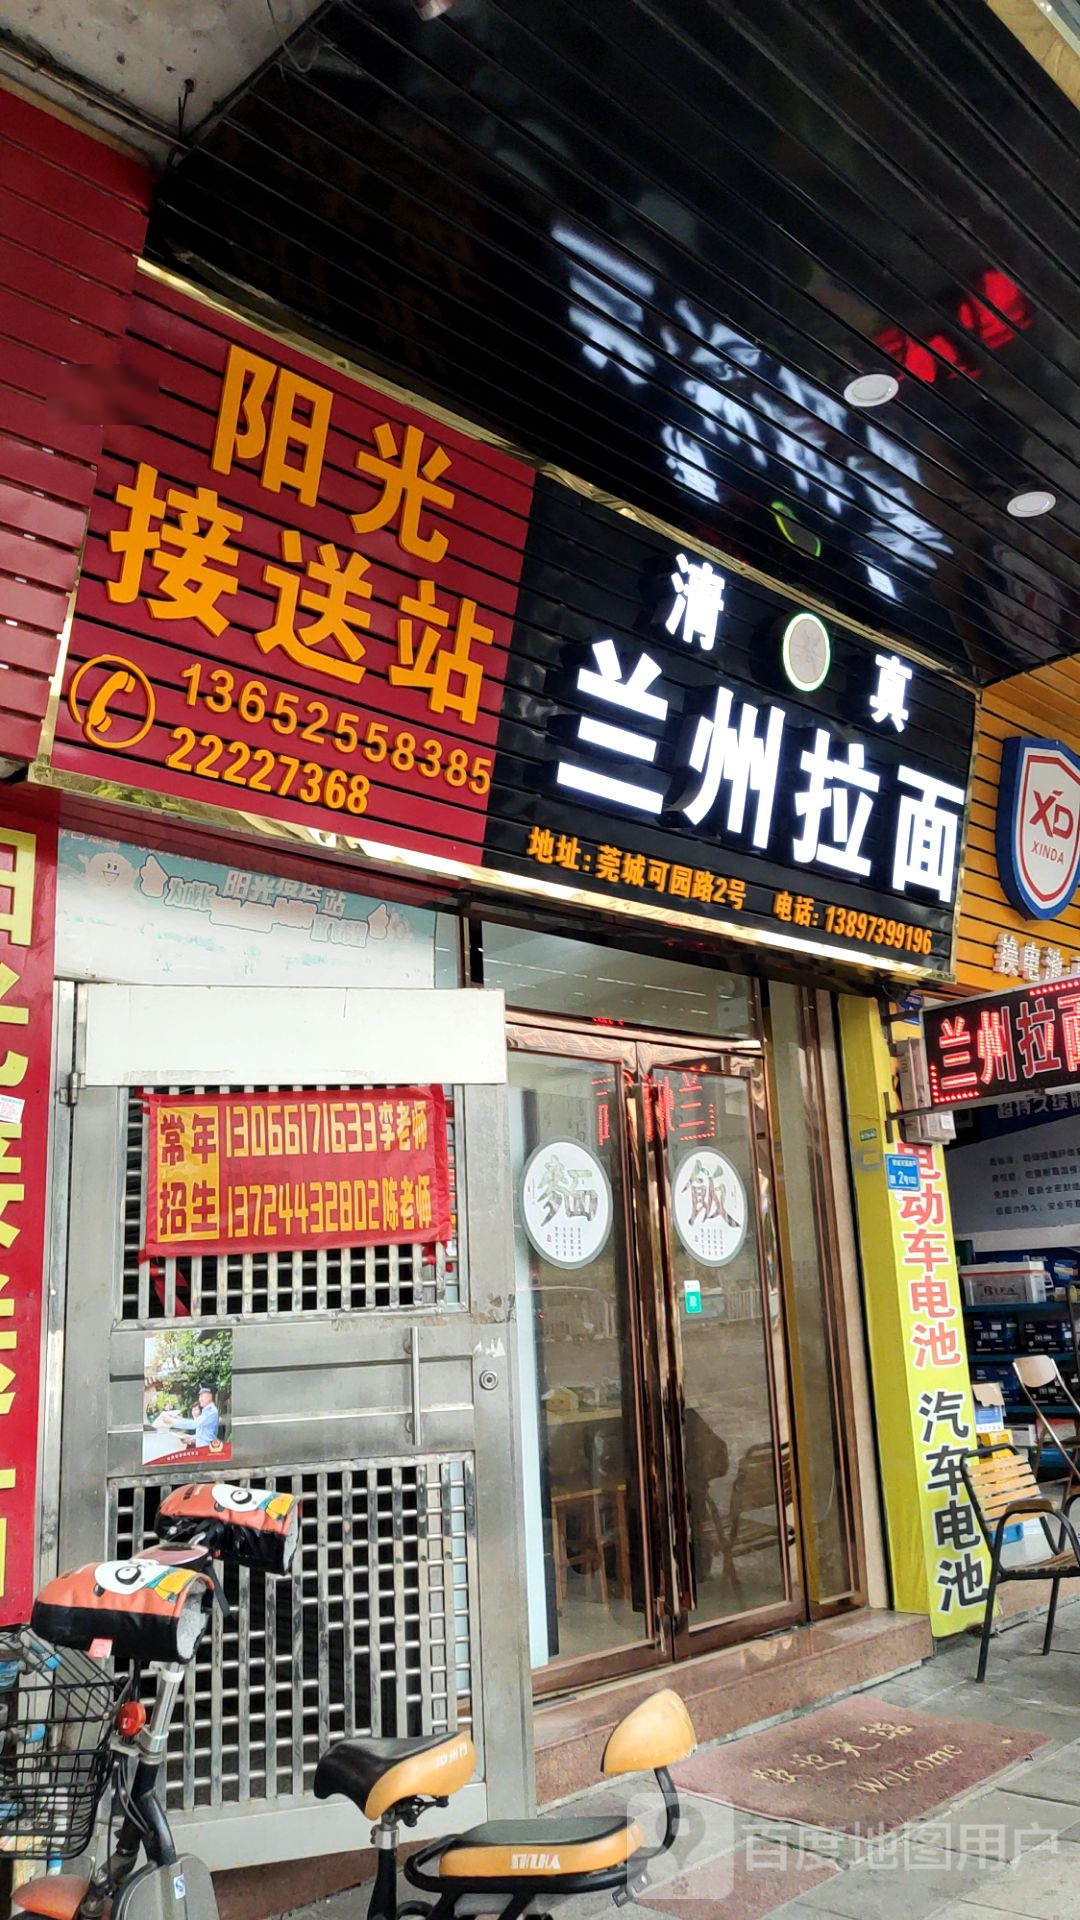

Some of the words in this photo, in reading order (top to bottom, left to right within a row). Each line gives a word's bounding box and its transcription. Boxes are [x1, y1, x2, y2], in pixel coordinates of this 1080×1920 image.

[211, 344, 455, 562] 阳光
[106, 462, 494, 724] 接送站
[665, 553, 726, 652] 清
[870, 655, 913, 733] 真
[166, 726, 371, 814] 22227368
[181, 662, 492, 795] 13652558385
[556, 639, 966, 902] 兰州拉面
[1032, 840, 1065, 866] XINDA
[161, 1113, 217, 1166] 常年
[160, 1180, 217, 1236] 招生
[918, 1391, 988, 1612] 汽车电池
[855, 1743, 964, 1794] Welcome
